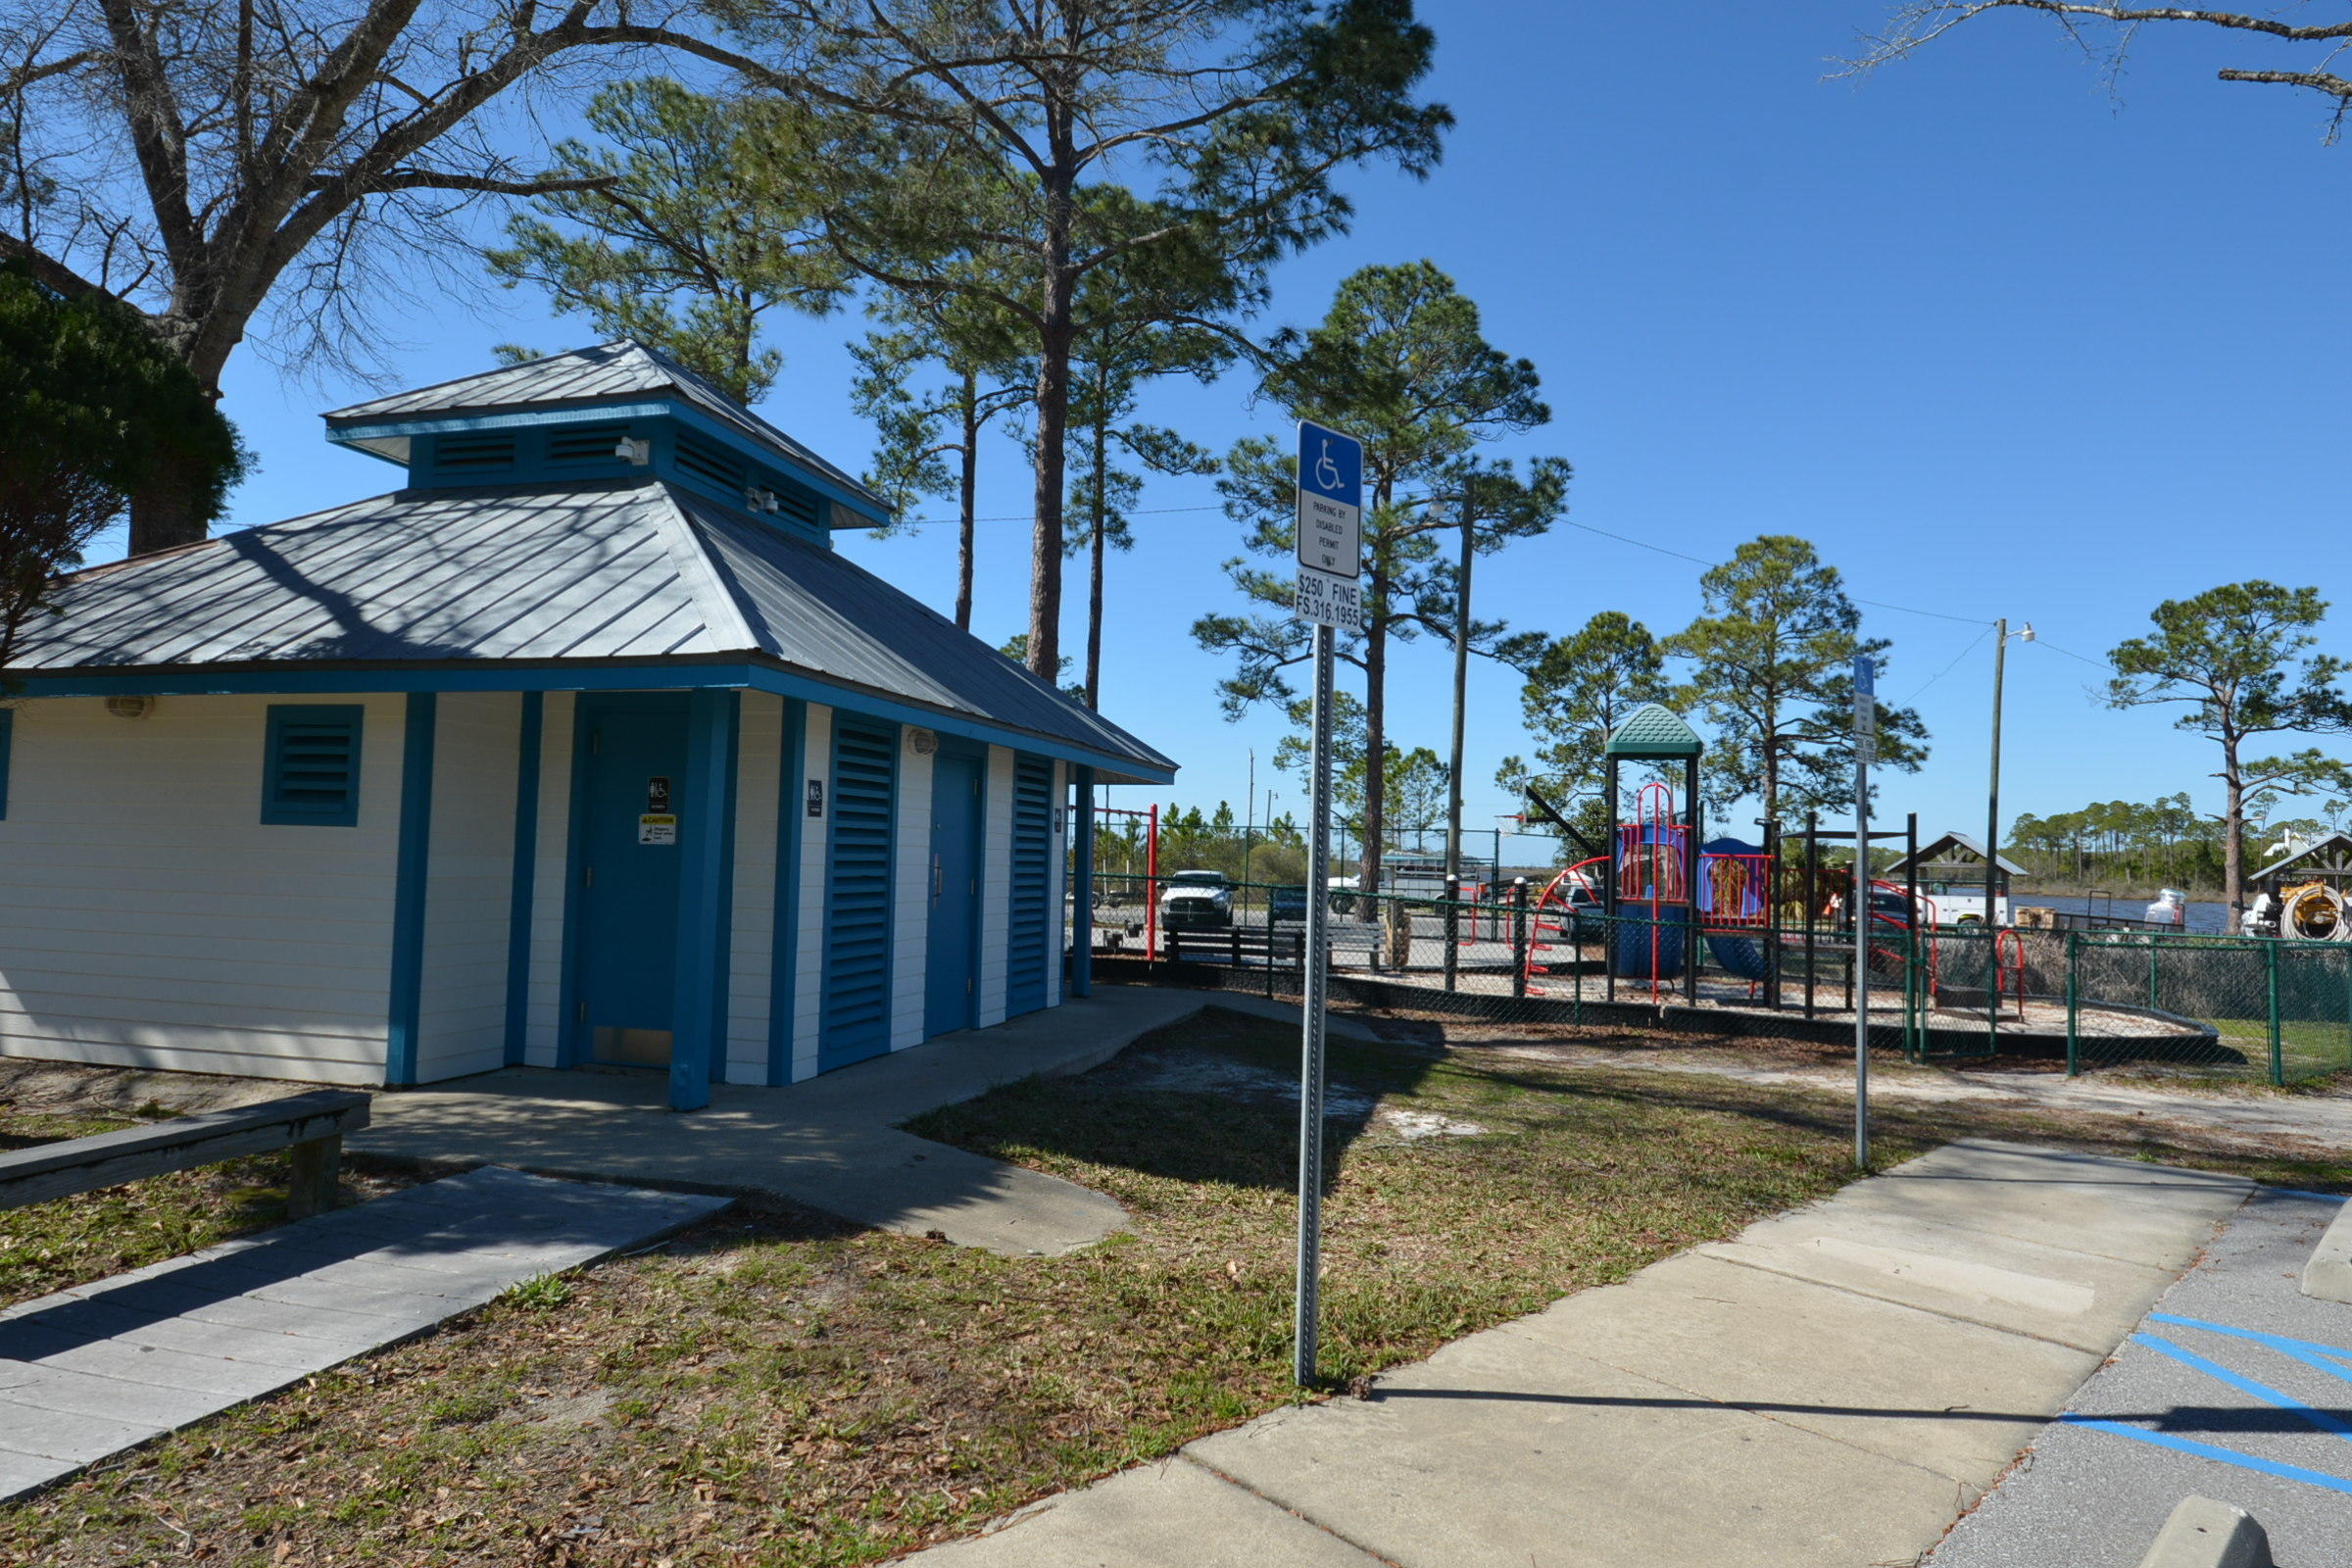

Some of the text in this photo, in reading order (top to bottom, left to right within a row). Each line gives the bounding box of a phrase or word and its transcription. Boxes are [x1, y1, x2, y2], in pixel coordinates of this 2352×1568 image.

[1313, 501, 1347, 519] PARKING BY
[1315, 518, 1344, 535] DISABLED
[1319, 536, 1340, 551] PERMIT
[1321, 554, 1336, 566] ONLY
[1298, 573, 1357, 607] $250 FINE
[1296, 595, 1359, 626] FS.316.1955
